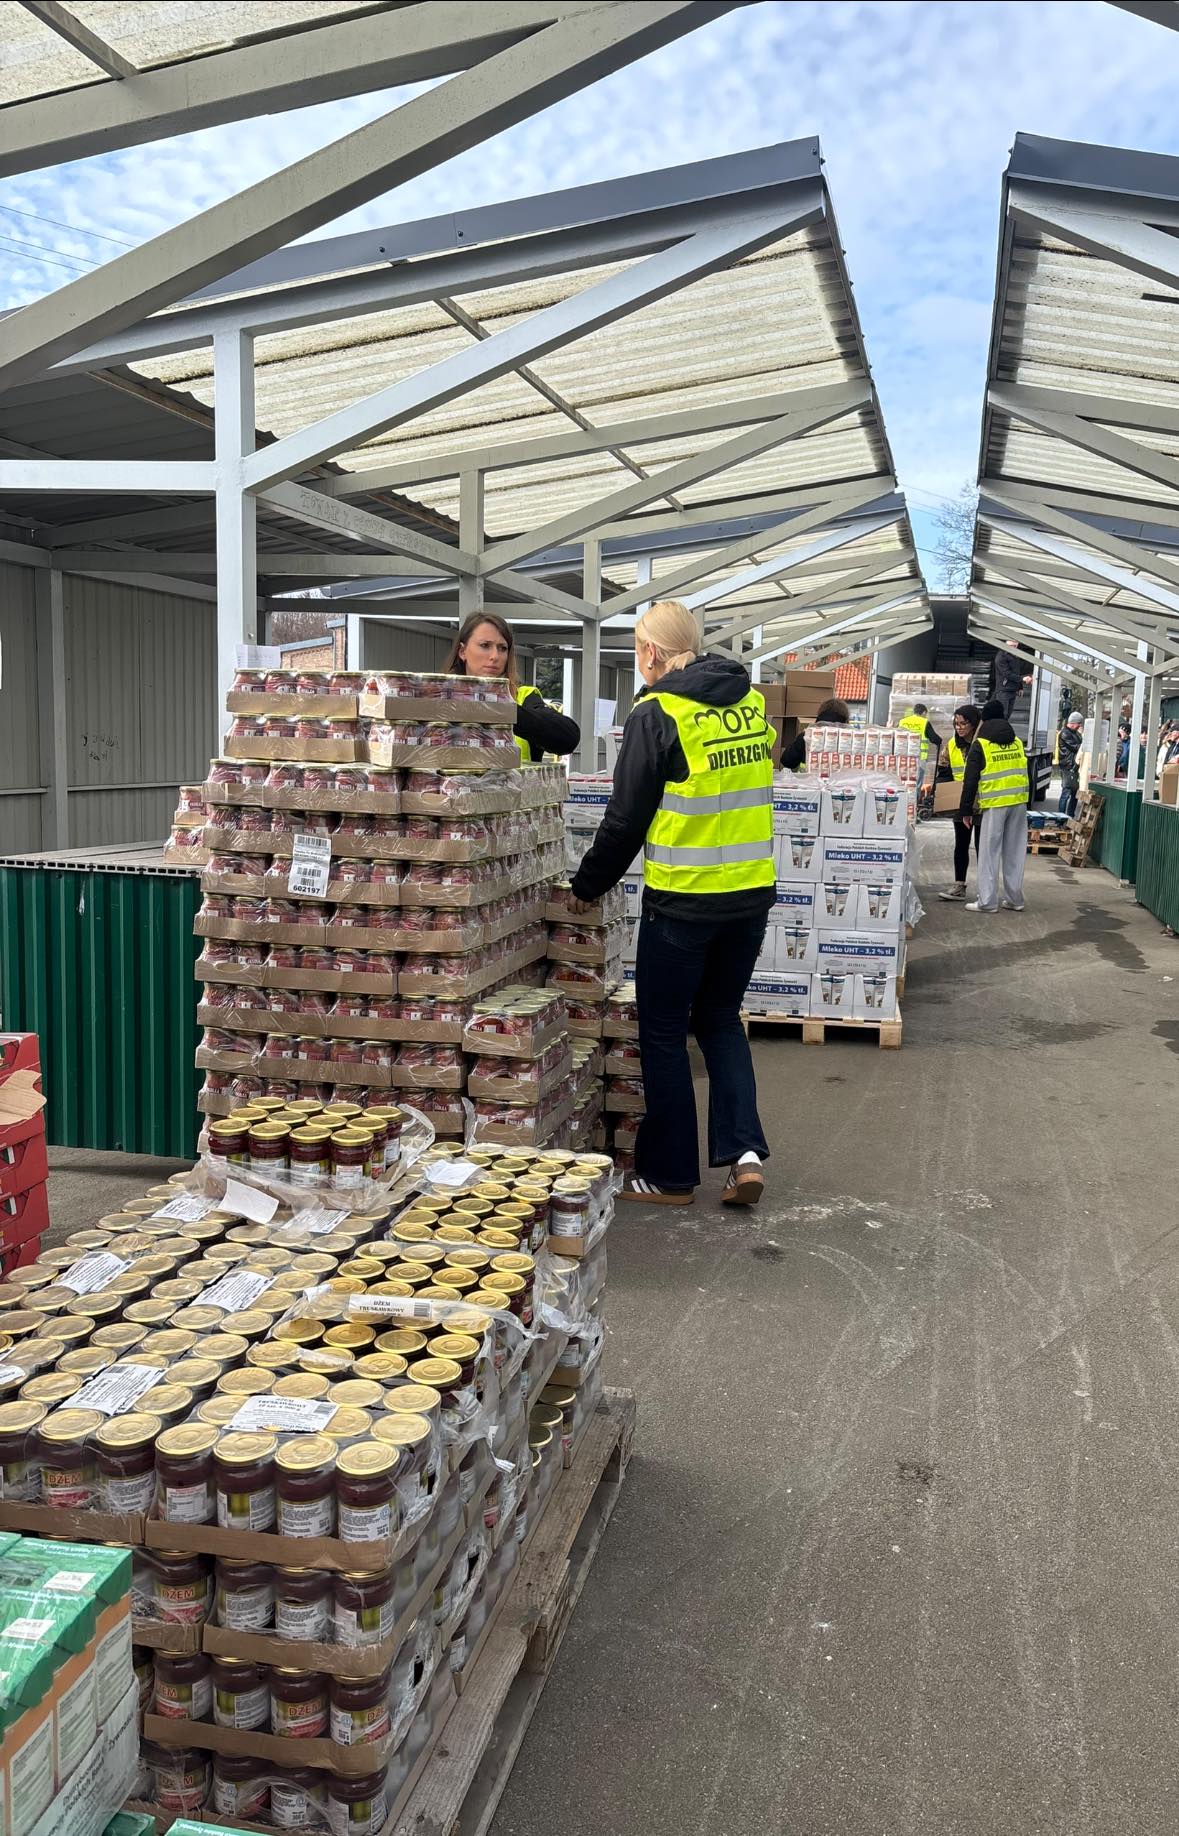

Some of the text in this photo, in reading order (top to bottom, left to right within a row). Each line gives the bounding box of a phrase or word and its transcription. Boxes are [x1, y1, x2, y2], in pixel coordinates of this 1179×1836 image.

[293, 884, 321, 894] 602197
[821, 945, 843, 953] Mleko
[161, 1587, 195, 1600] DŻEM
